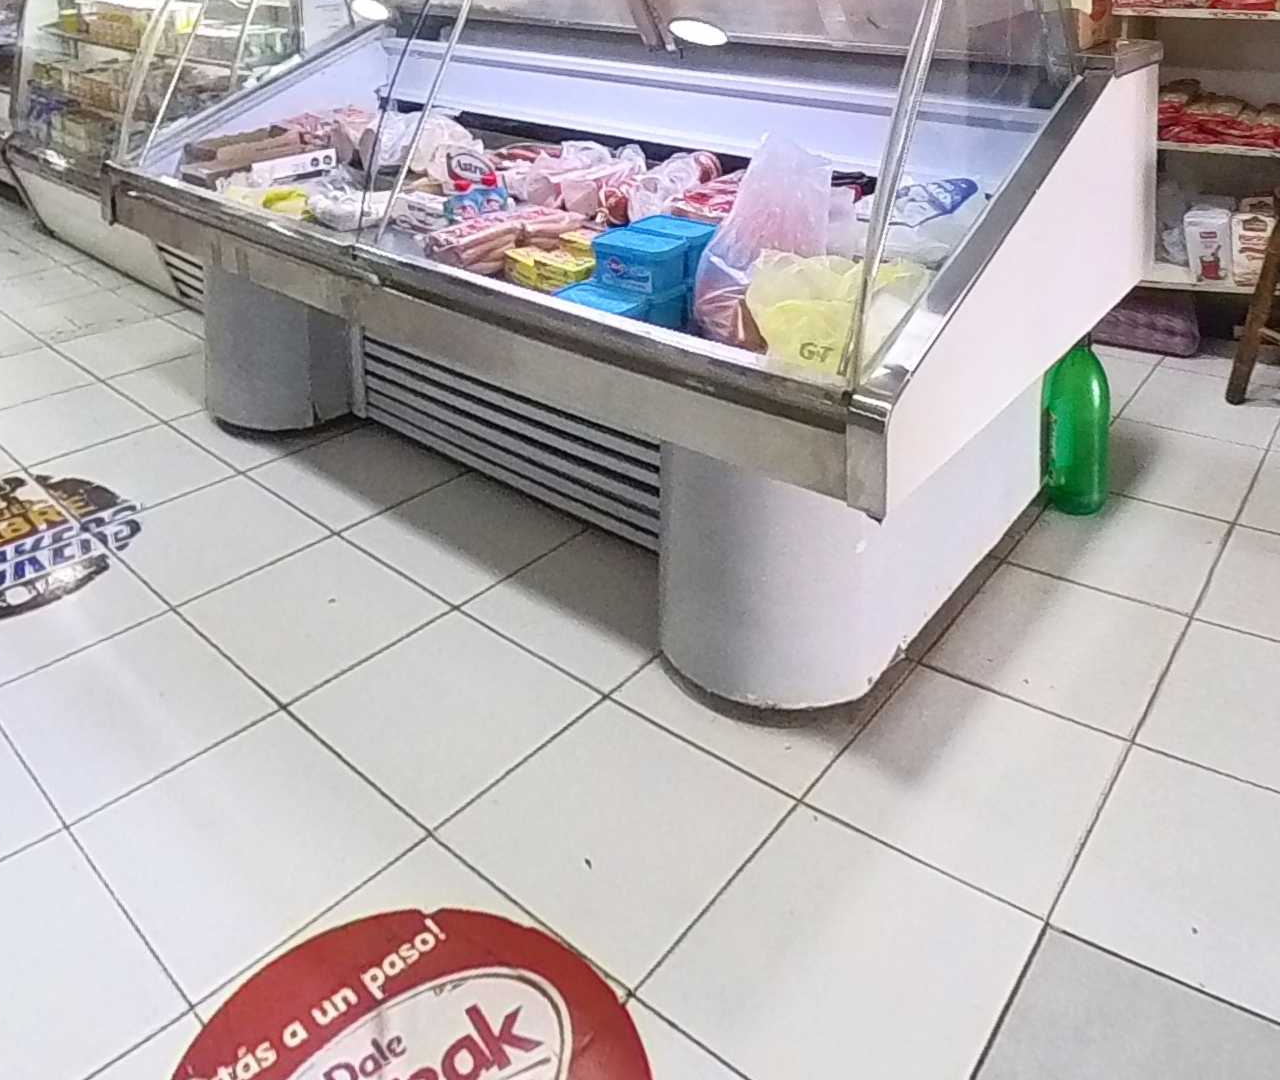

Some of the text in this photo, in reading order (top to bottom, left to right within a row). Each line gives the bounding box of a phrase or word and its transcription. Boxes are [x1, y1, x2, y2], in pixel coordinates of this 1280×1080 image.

[282, 1022, 309, 1050] a
[310, 985, 359, 1028] un
[360, 917, 447, 1000] paso!
